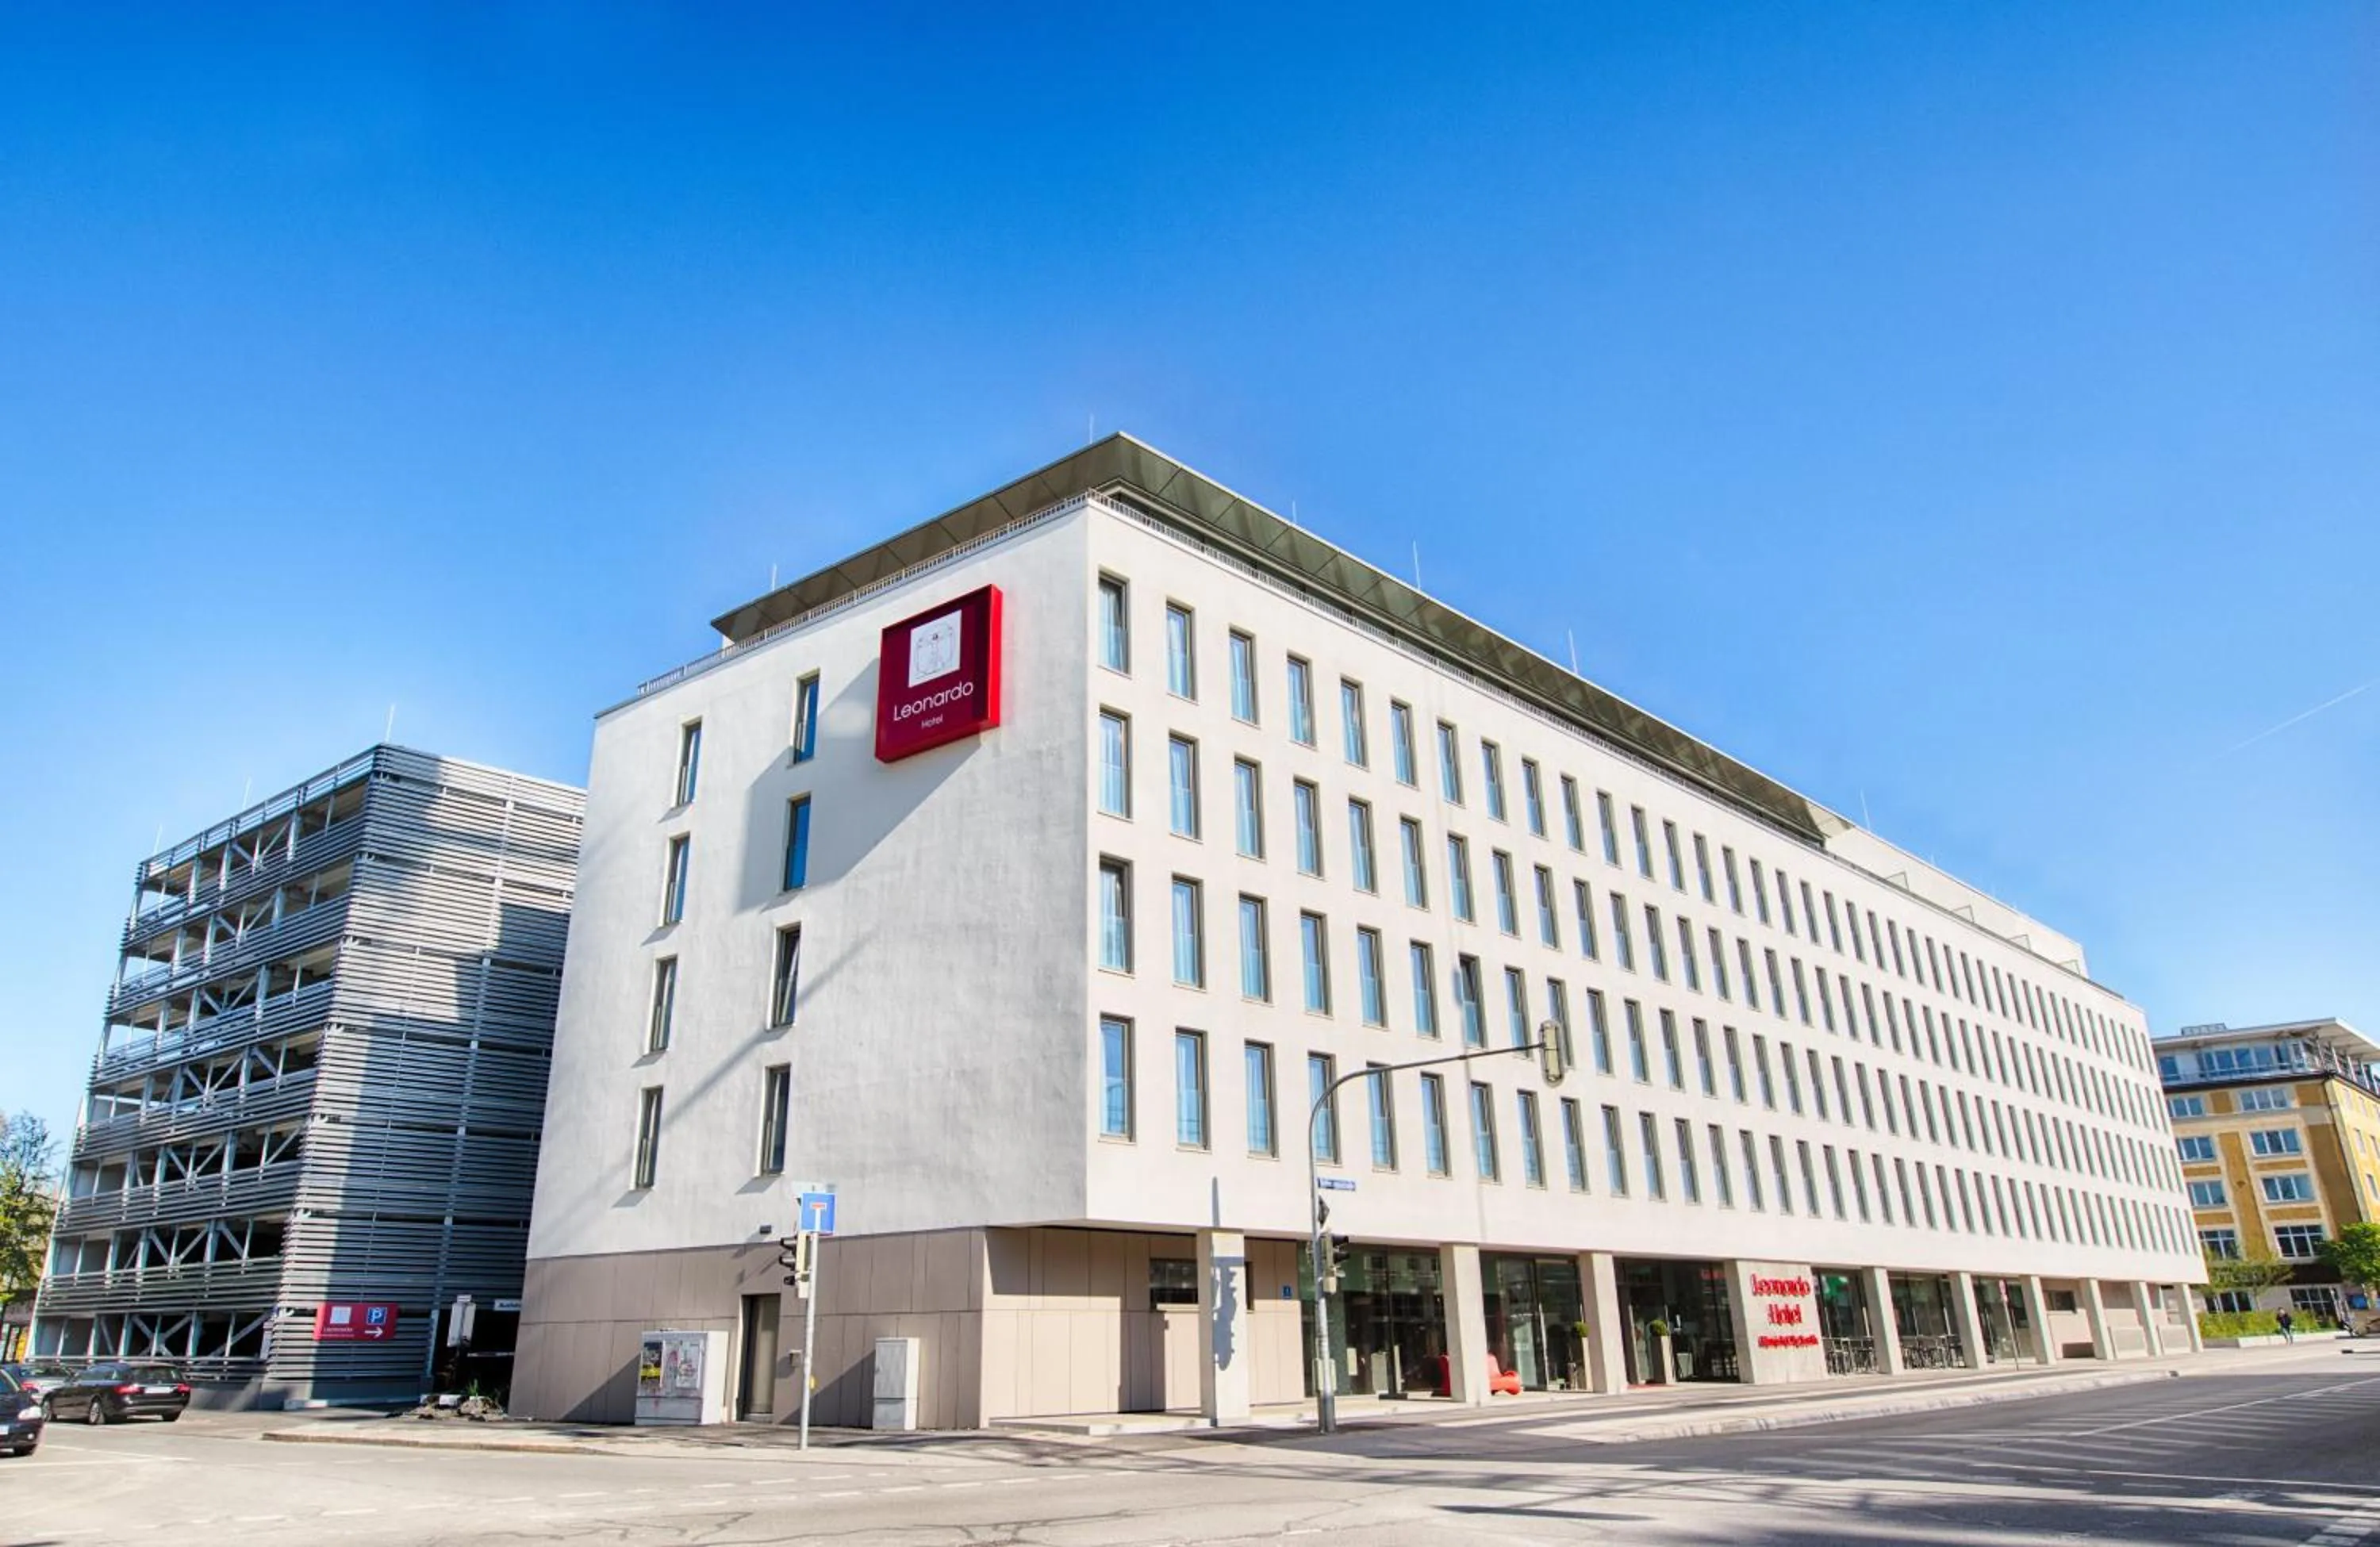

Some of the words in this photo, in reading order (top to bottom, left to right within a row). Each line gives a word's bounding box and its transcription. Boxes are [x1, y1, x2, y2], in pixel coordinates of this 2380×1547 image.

[893, 681, 973, 721] Leonardo
[921, 714, 943, 729] Hotel
[1751, 1274, 1810, 1296] Leonardo
[371, 1310, 382, 1323] P
[1768, 1303, 1802, 1326] Hotel
